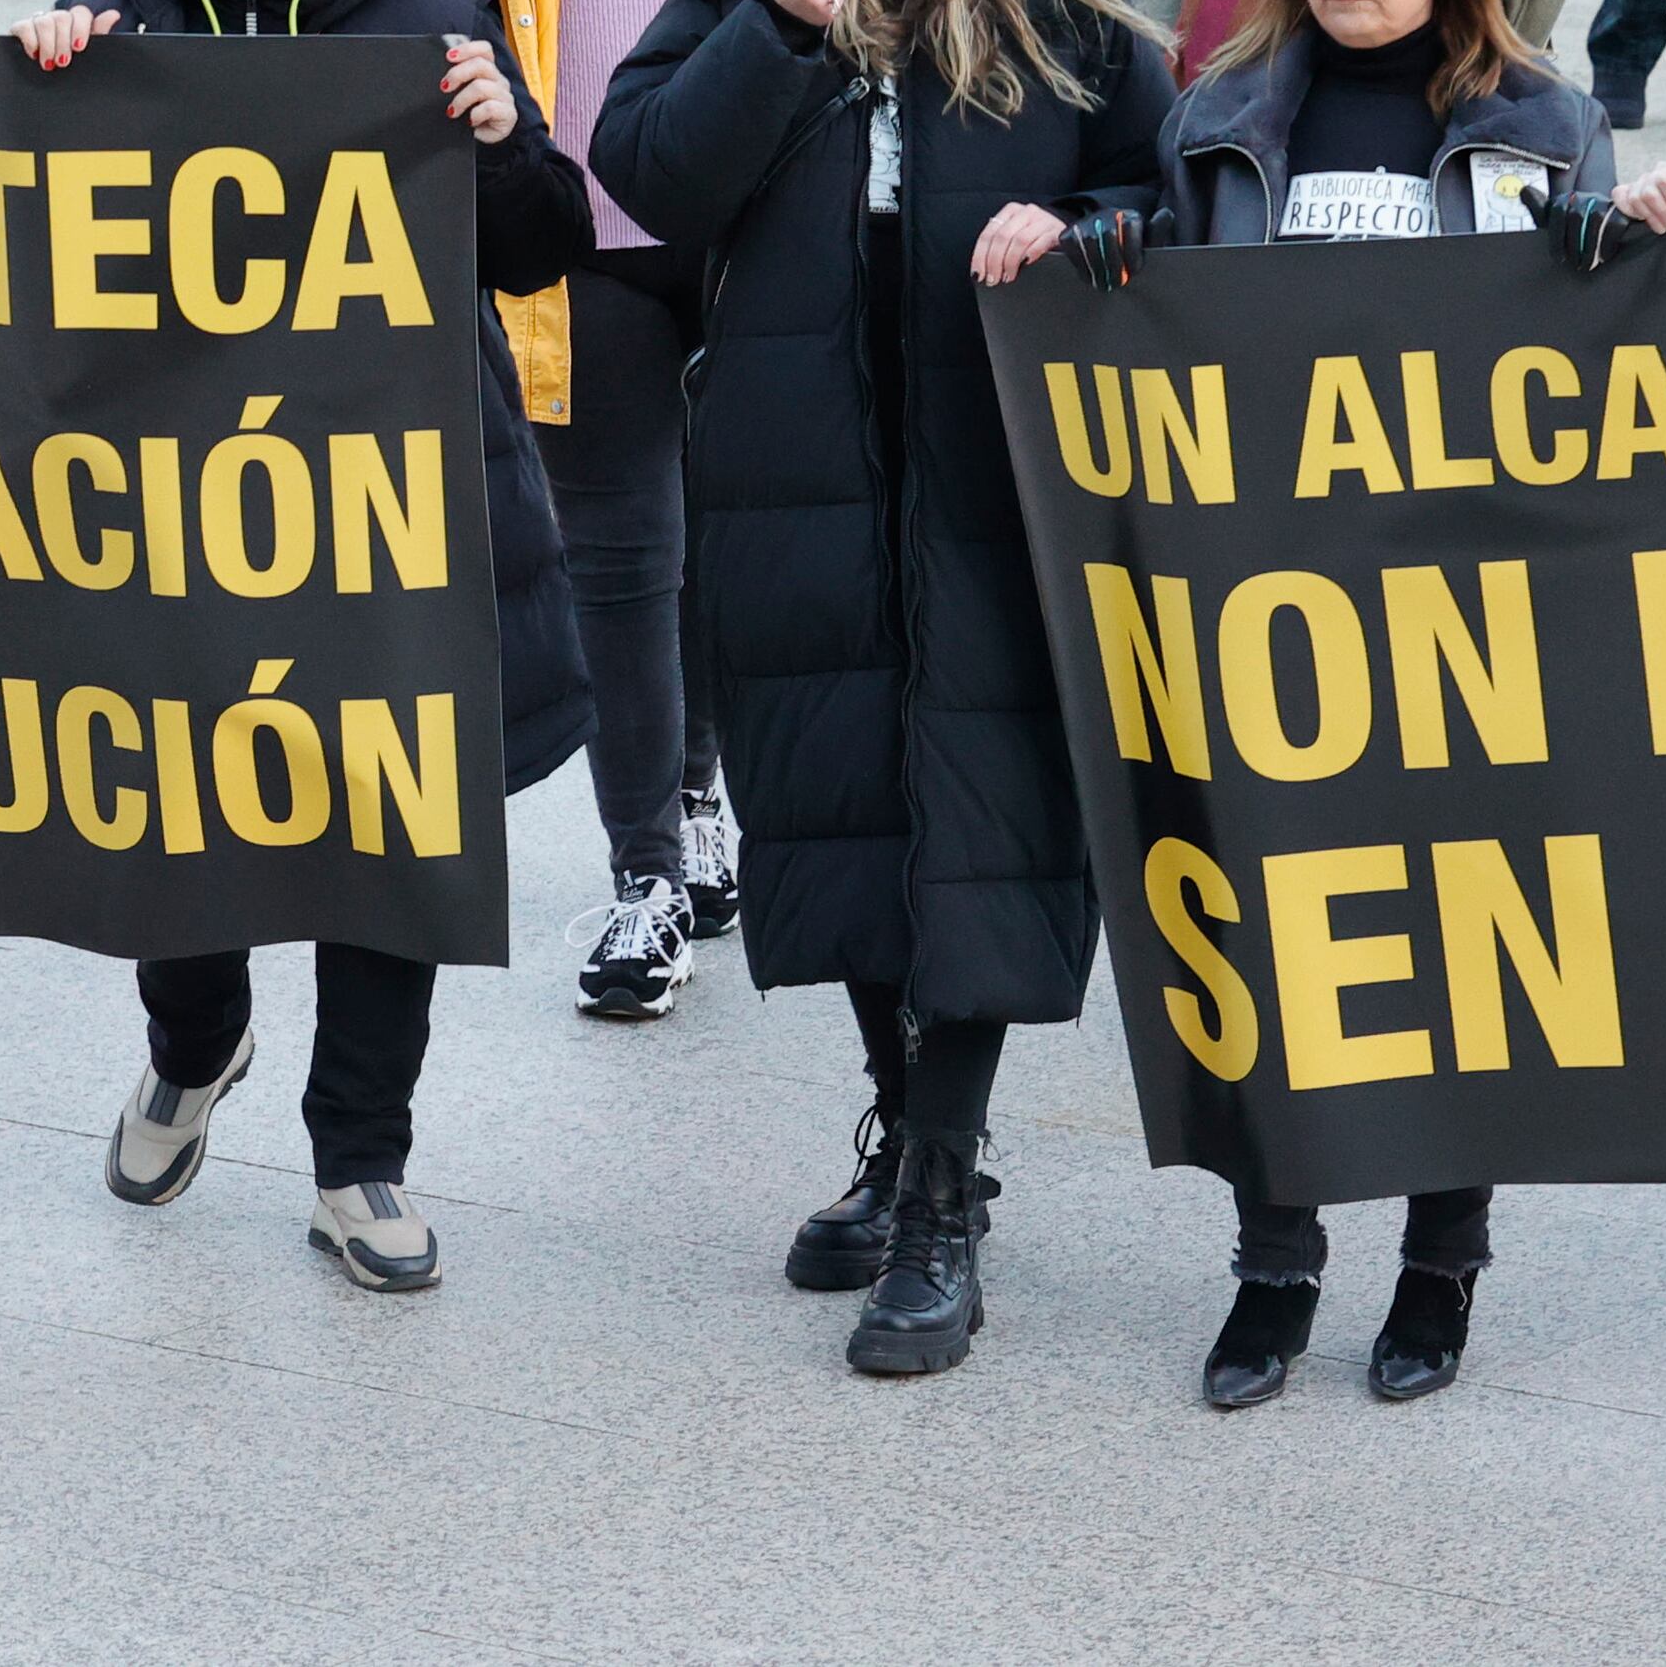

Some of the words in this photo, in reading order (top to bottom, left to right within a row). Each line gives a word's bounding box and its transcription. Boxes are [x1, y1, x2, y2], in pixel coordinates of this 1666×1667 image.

[1292, 180, 1302, 198] A
[1309, 176, 1393, 201] BIBLIOTECA
[1400, 182, 1433, 205] MER
[1042, 361, 1236, 505] UN
[1083, 559, 1550, 783] NON
[1144, 833, 1626, 1092] SEN
